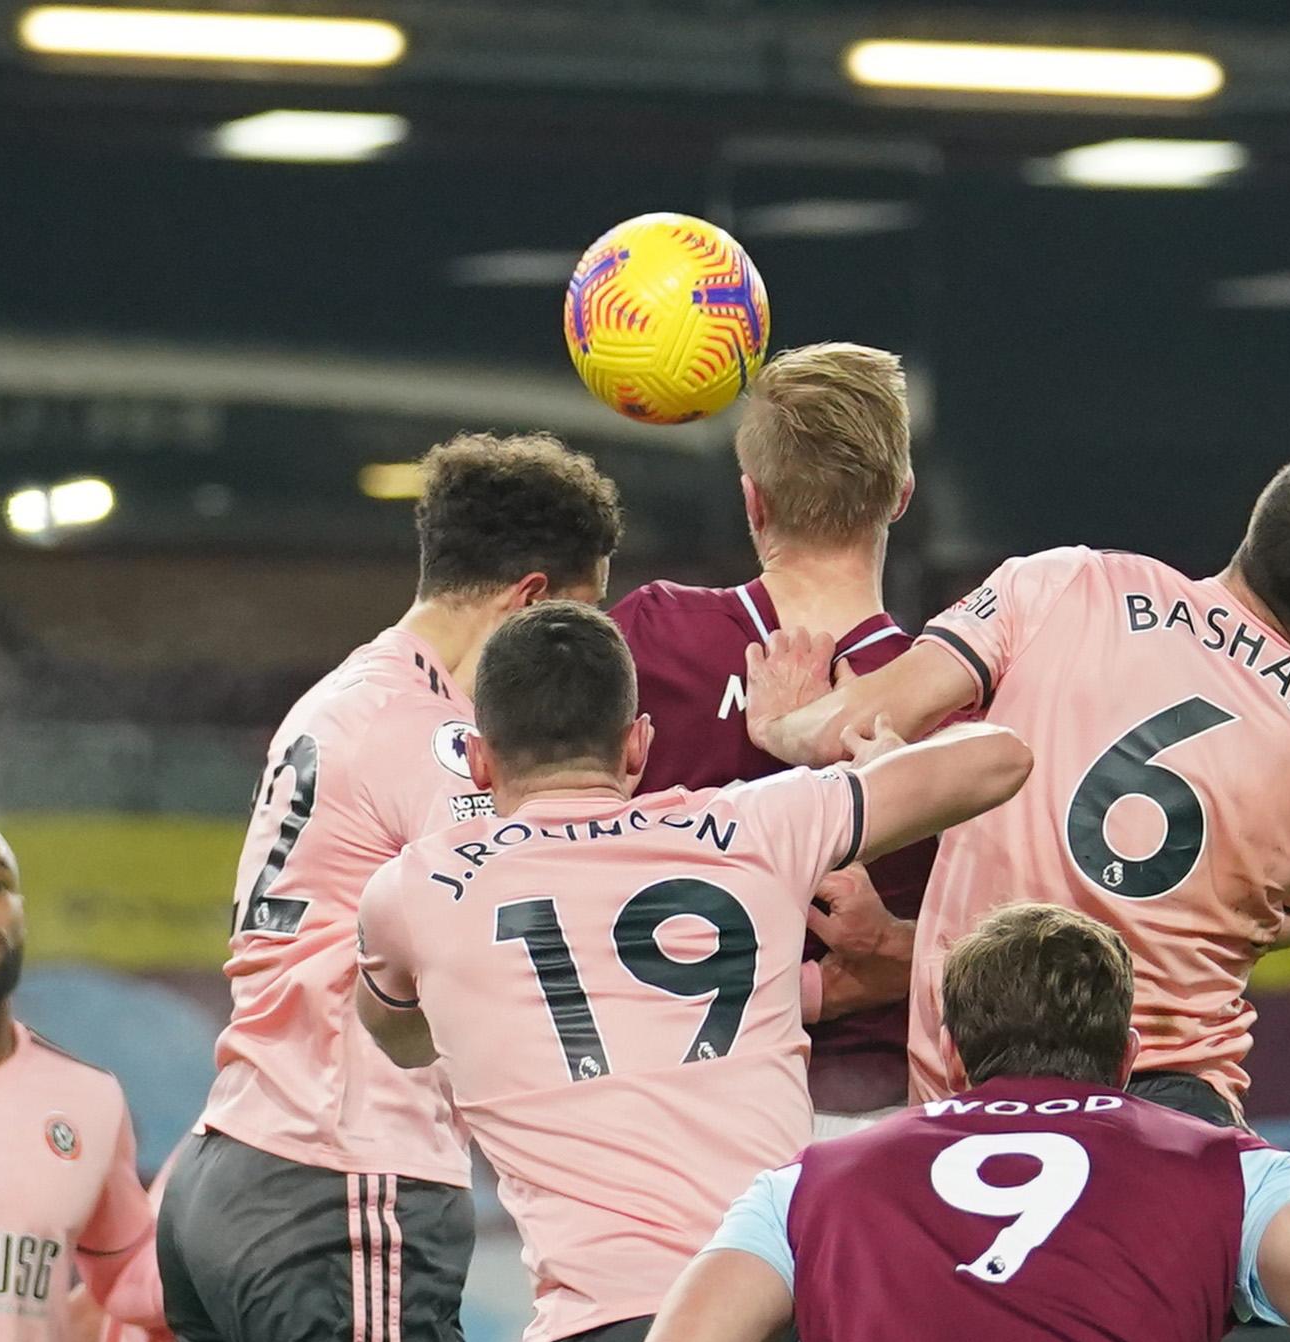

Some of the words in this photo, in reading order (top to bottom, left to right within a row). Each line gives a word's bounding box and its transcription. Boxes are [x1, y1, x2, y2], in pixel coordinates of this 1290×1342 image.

[429, 809, 739, 902] J.ROINON
[1066, 695, 1242, 899] 6
[491, 874, 761, 1083] 19
[923, 1095, 1124, 1117] WOOD
[930, 1131, 1091, 1284] 9
